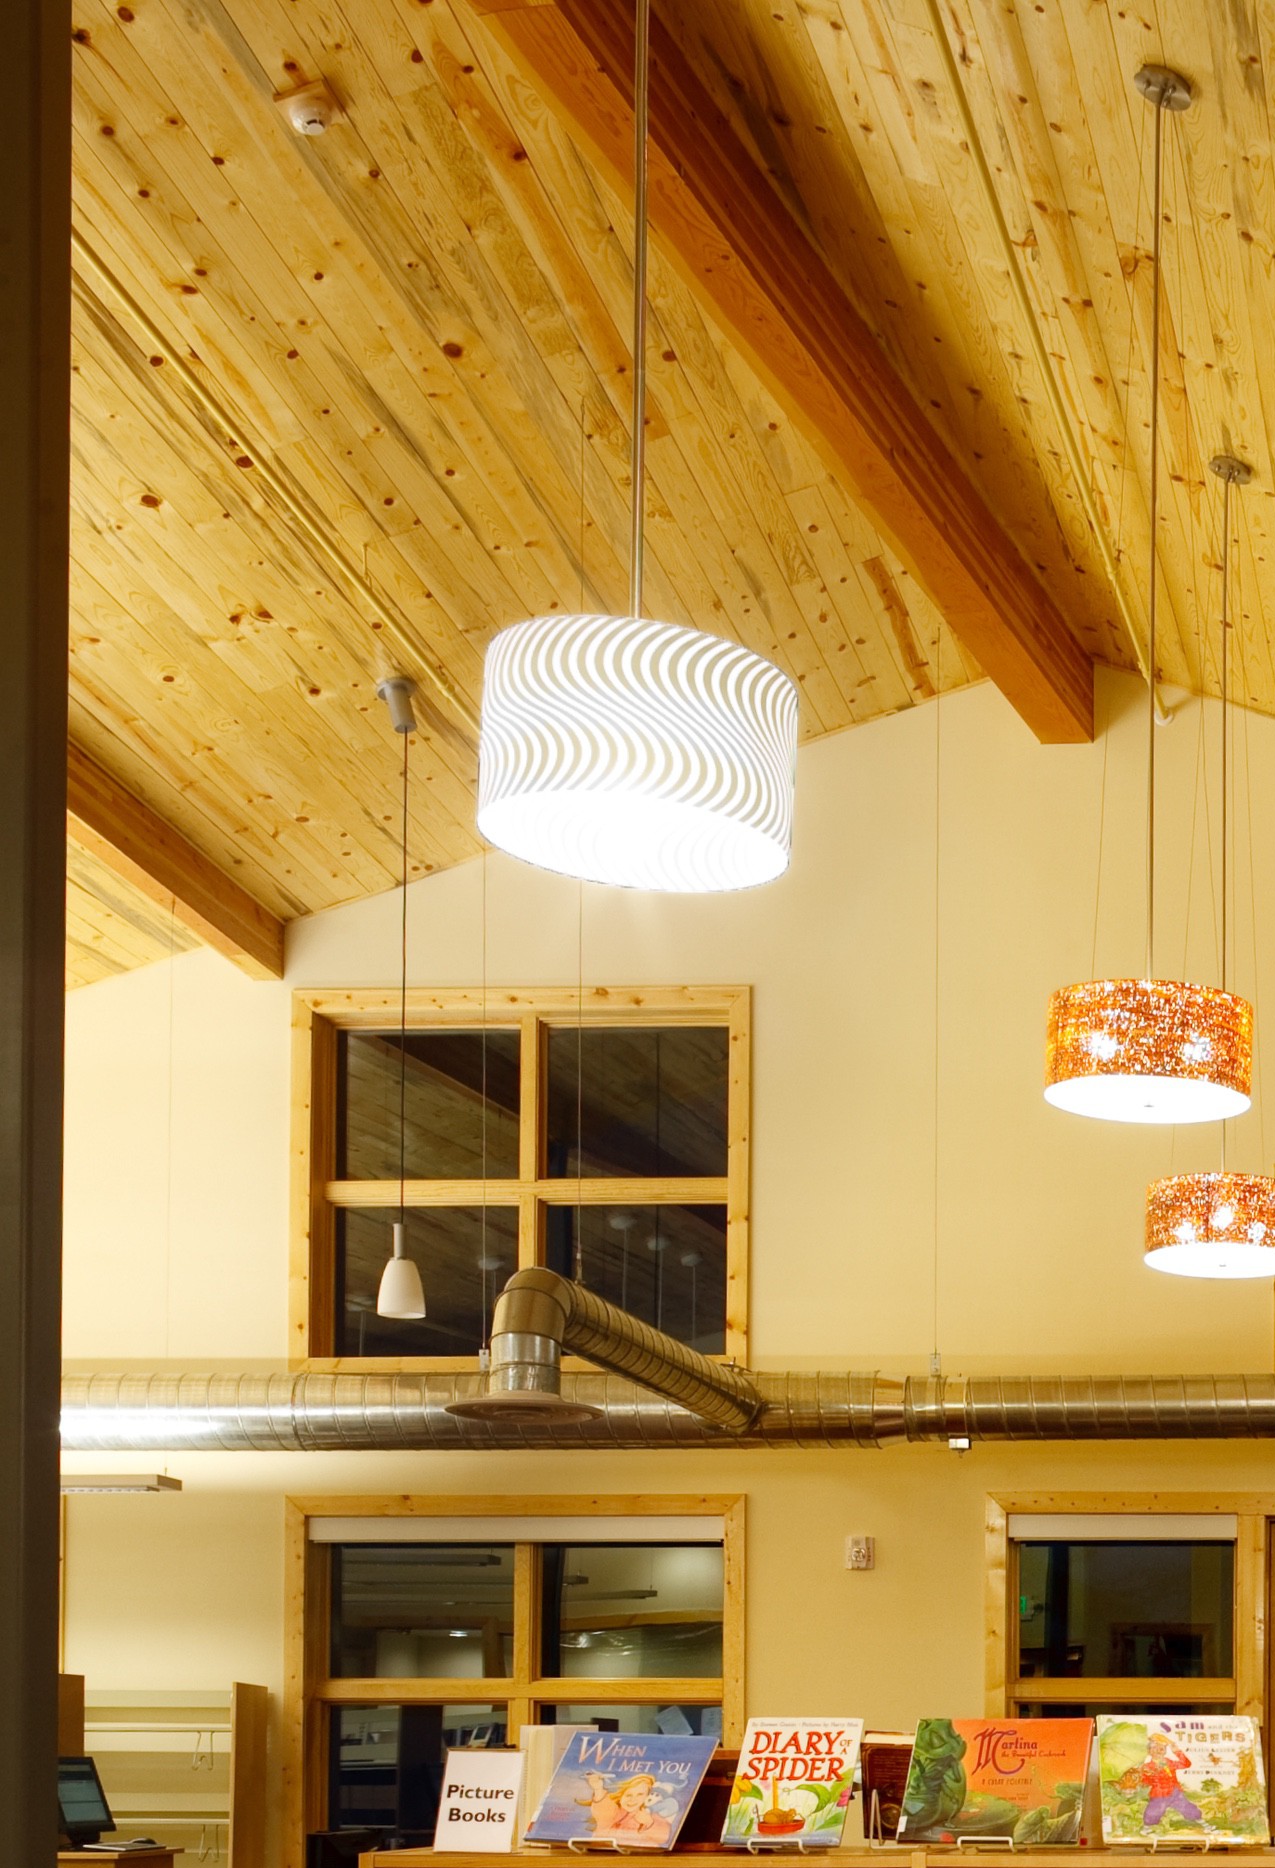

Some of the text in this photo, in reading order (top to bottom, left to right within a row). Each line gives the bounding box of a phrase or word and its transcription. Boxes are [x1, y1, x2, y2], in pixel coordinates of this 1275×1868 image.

[1160, 1721, 1204, 1733] Sam
[749, 1730, 852, 1755] DIARY OF
[1175, 1732, 1246, 1744] TIGERS
[577, 1736, 647, 1764] WHEN
[972, 1727, 1038, 1774] Martina
[607, 1760, 692, 1775] I MET YOU
[742, 1757, 844, 1782] SPIDER
[446, 1784, 514, 1800] Picture
[448, 1808, 506, 1822] Books
